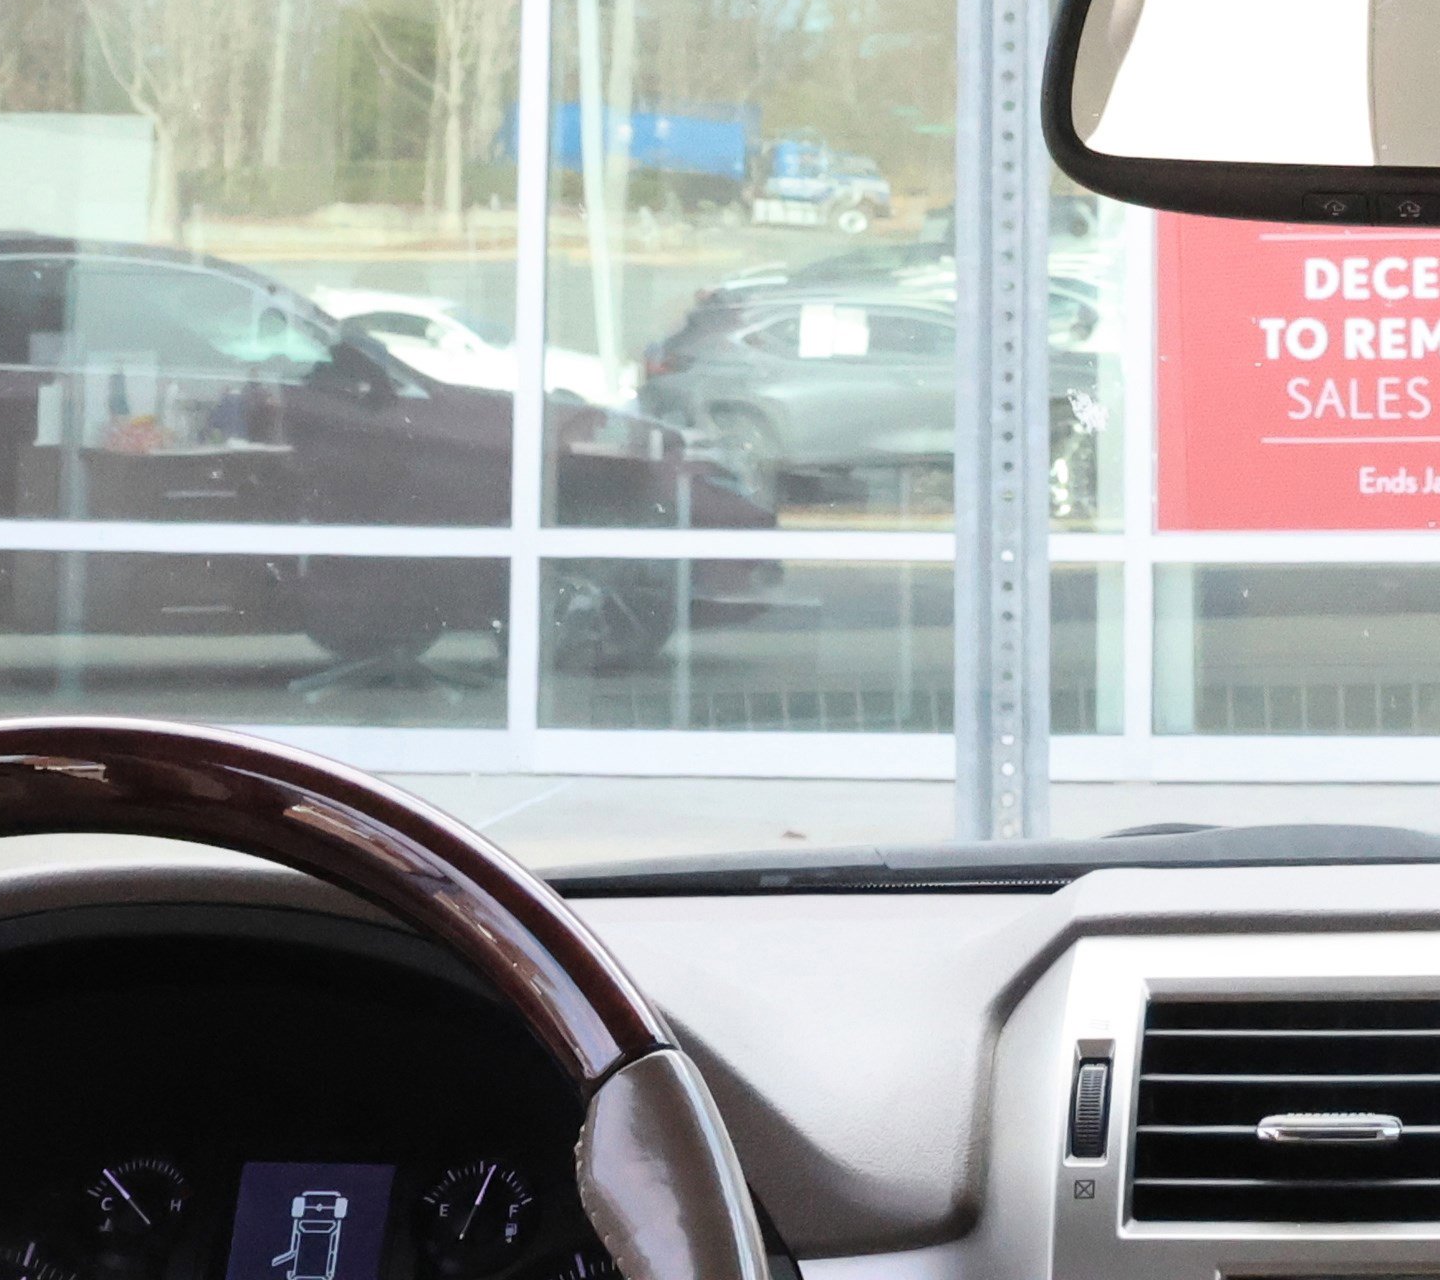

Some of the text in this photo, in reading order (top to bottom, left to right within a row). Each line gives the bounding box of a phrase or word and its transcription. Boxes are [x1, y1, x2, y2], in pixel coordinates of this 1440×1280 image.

[1259, 318, 1329, 360] TO
[1286, 377, 1433, 421] SALES
[1359, 467, 1418, 495] Ends
[101, 1197, 112, 1211] C
[170, 1199, 182, 1212] H
[439, 1203, 450, 1217] E
[509, 1204, 519, 1217] F
